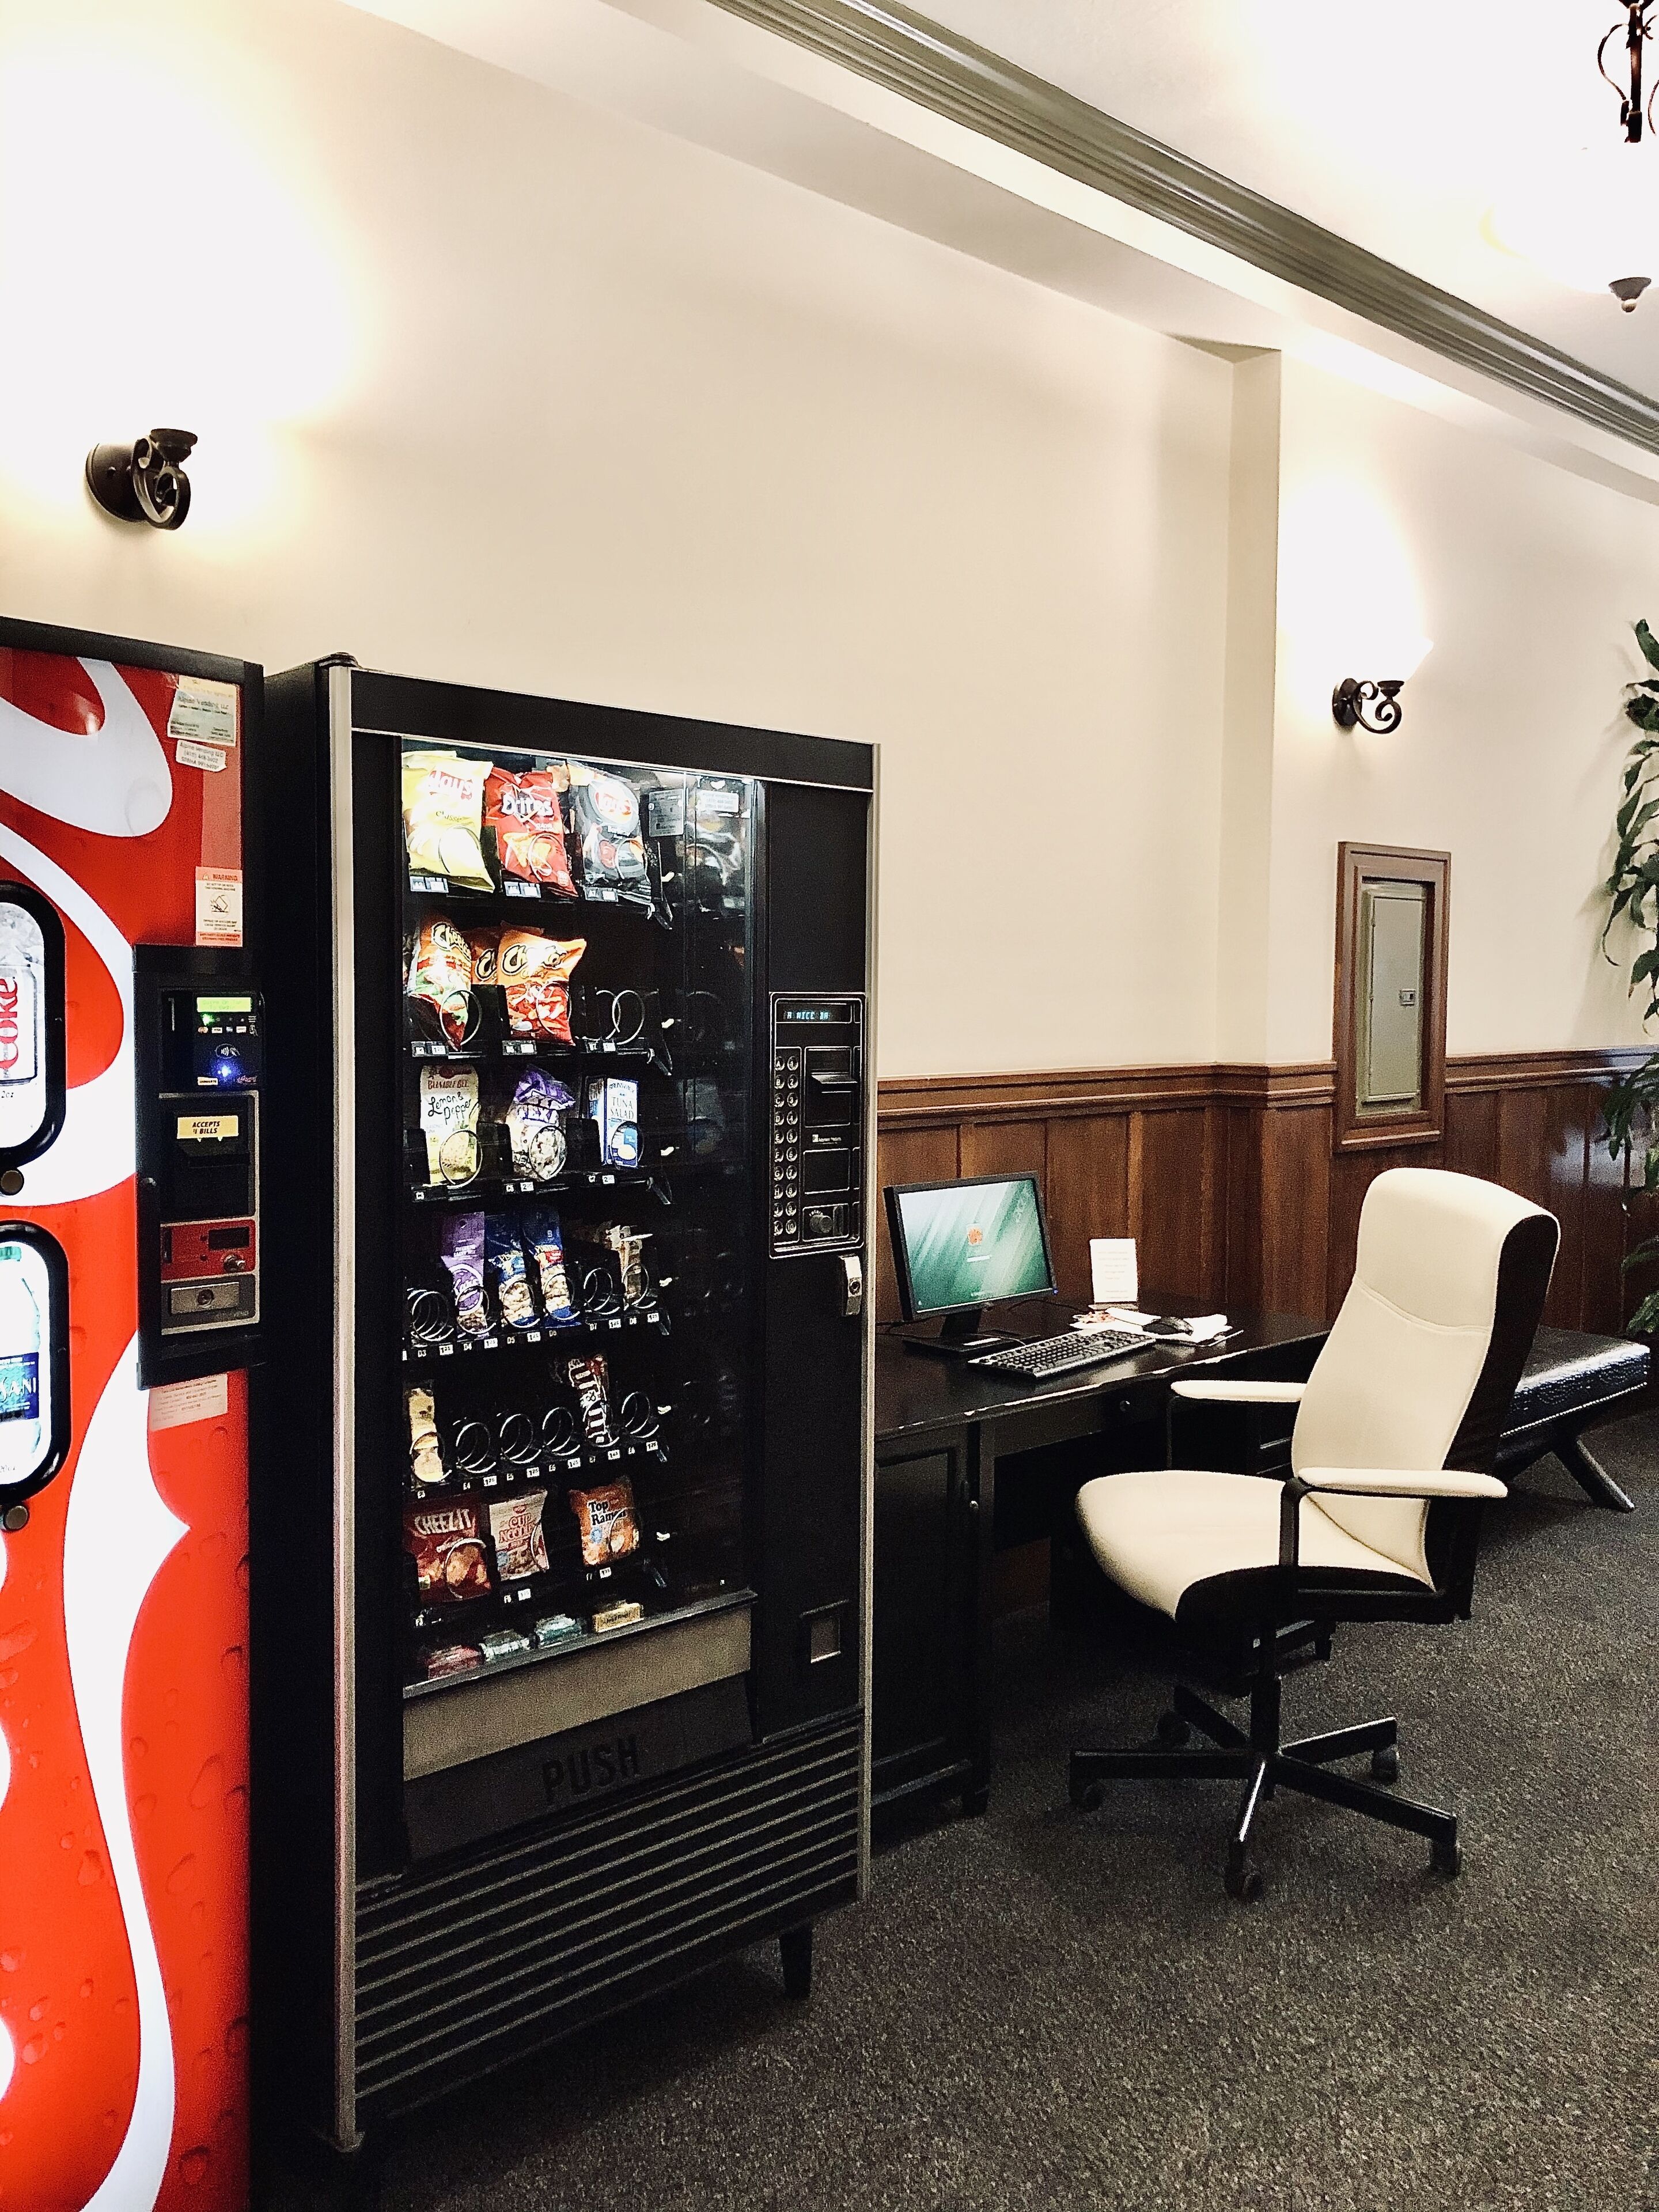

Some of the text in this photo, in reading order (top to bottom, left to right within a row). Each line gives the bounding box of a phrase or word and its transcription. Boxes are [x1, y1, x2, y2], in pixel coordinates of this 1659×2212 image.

[796, 1011, 815, 1020] NICE
[428, 1080, 455, 1090] BUMBLE
[428, 1096, 457, 1117] Lemon
[612, 1097, 633, 1109] TUNA
[611, 1108, 634, 1120] SALAD
[463, 1343, 472, 1351] D4
[588, 1501, 609, 1513] Top
[509, 1513, 531, 1528] CUP
[543, 1734, 639, 1806] PUSH
